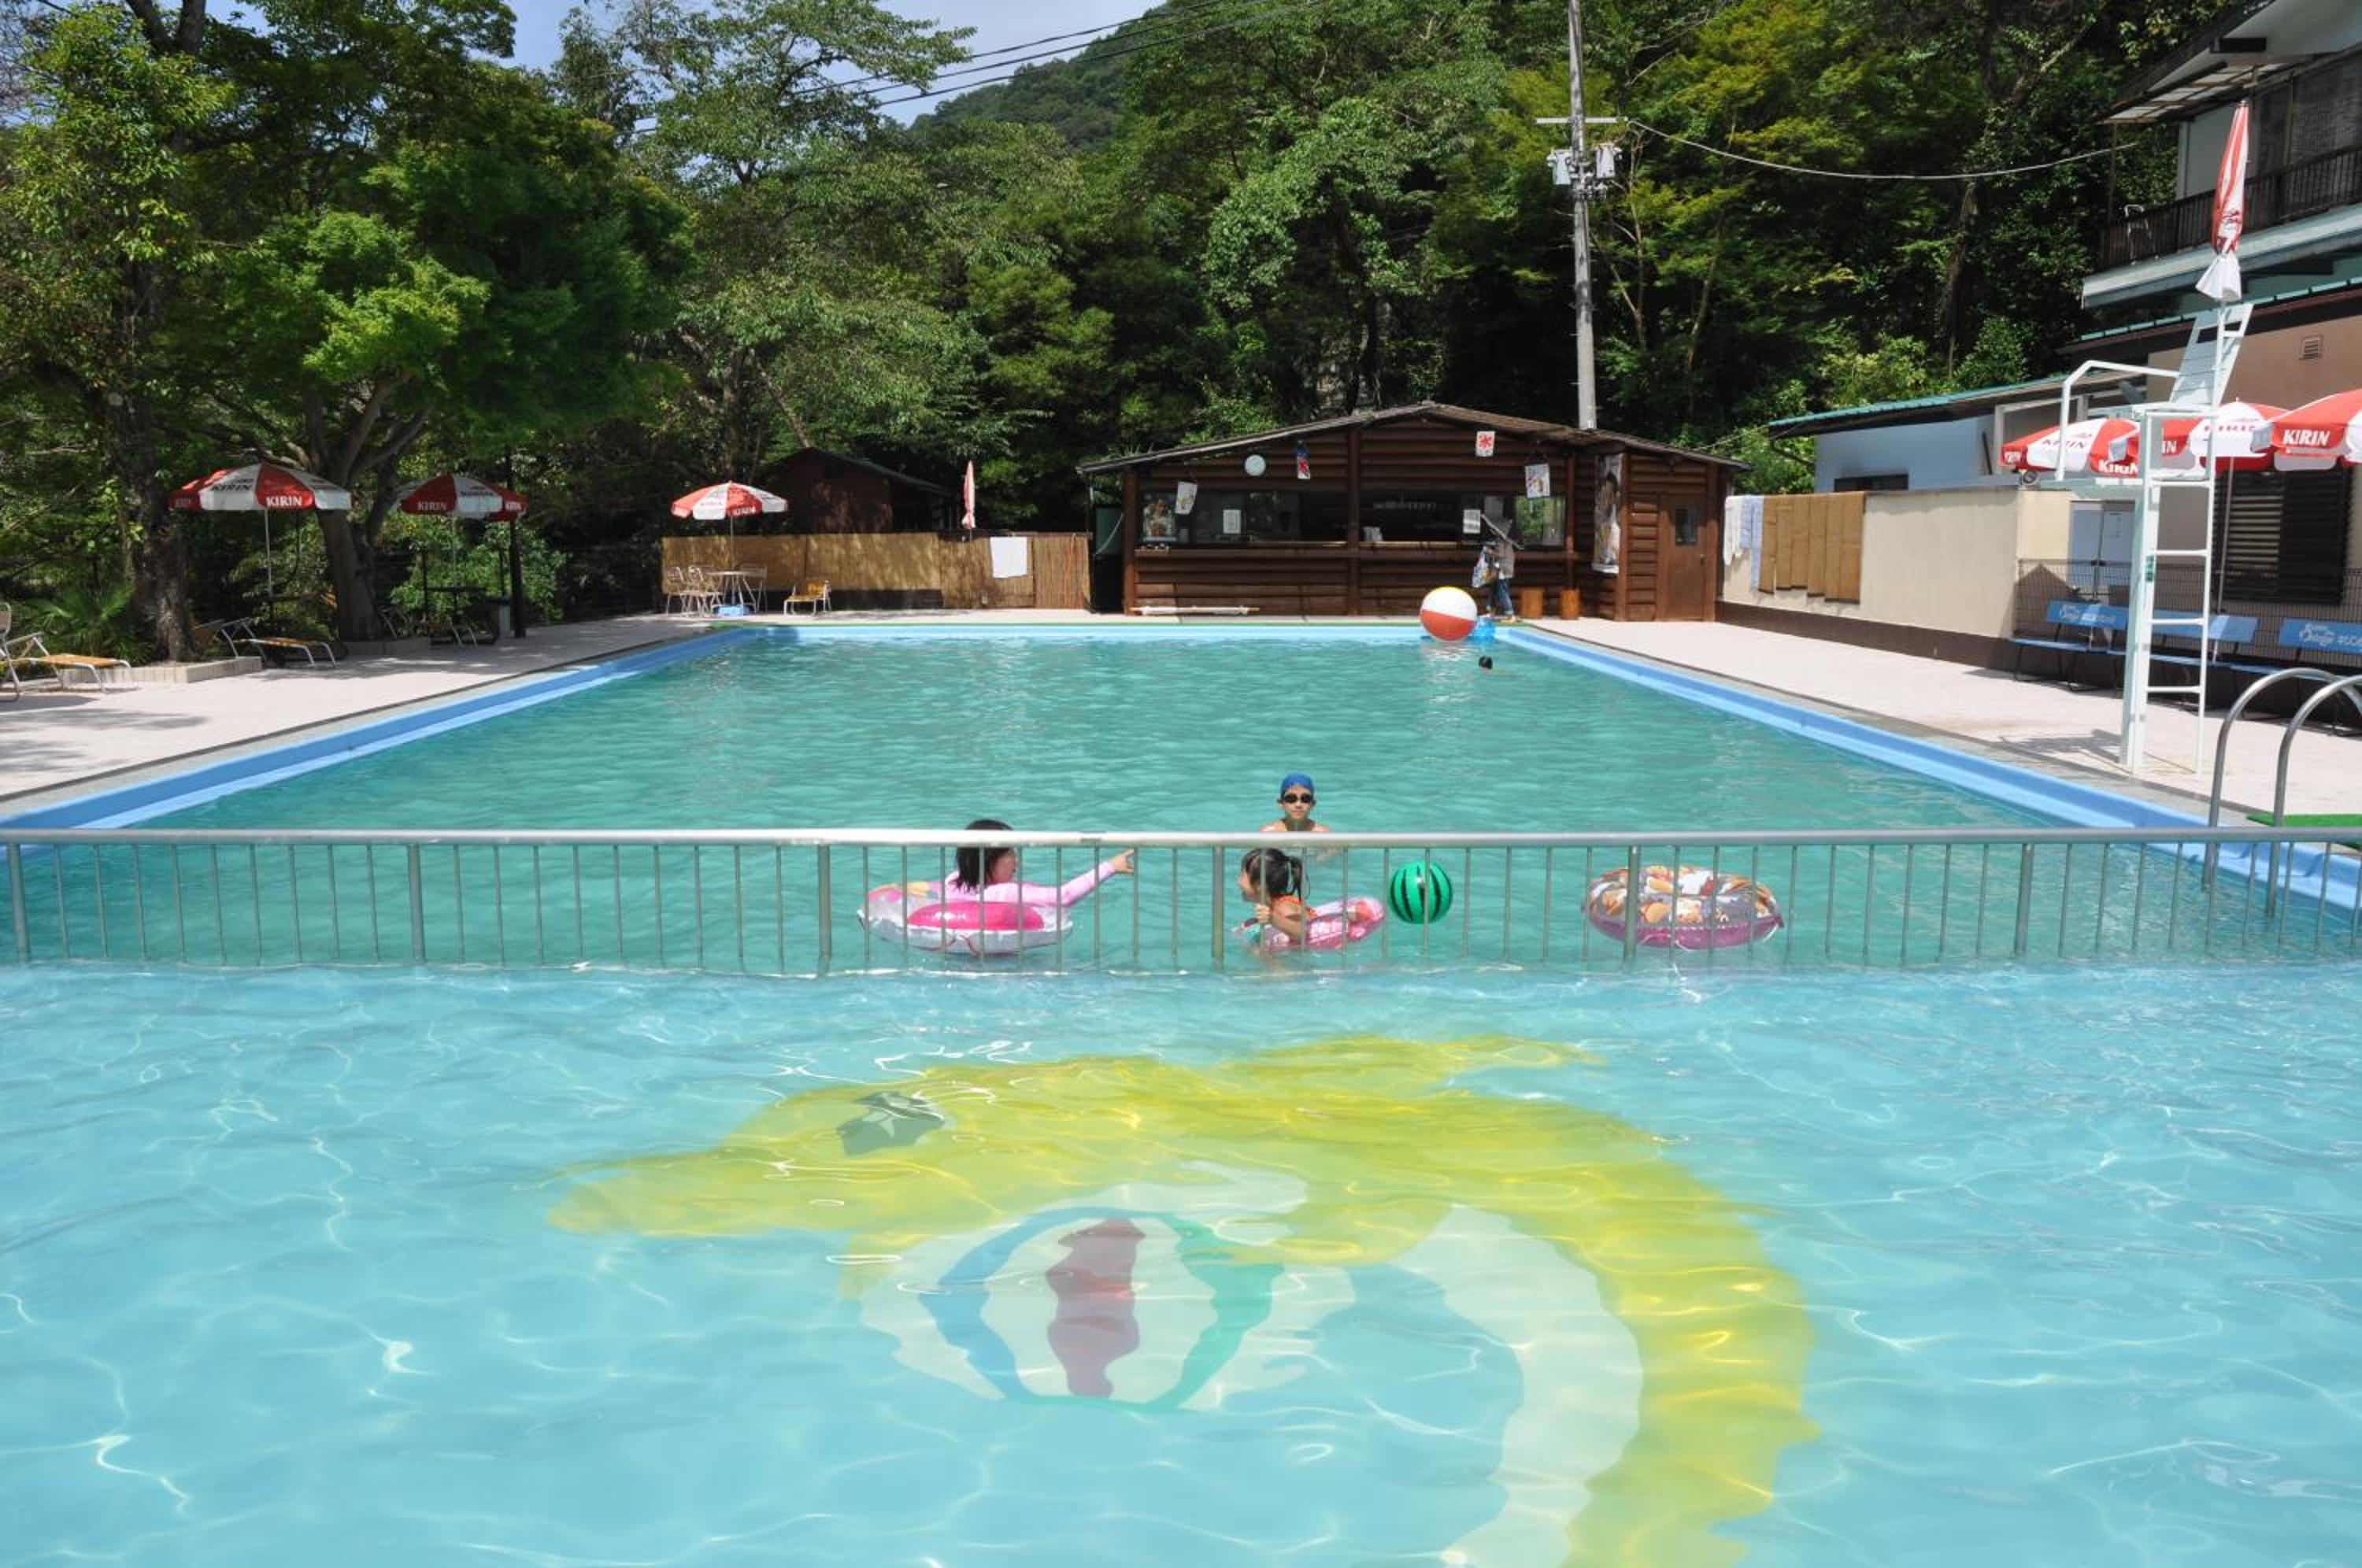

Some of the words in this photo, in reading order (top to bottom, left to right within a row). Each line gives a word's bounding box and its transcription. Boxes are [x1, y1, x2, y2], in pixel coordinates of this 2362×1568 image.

[2283, 429, 2331, 446] KIRIN
[265, 495, 303, 507] KIRIN
[416, 501, 447, 511] KIRIN
